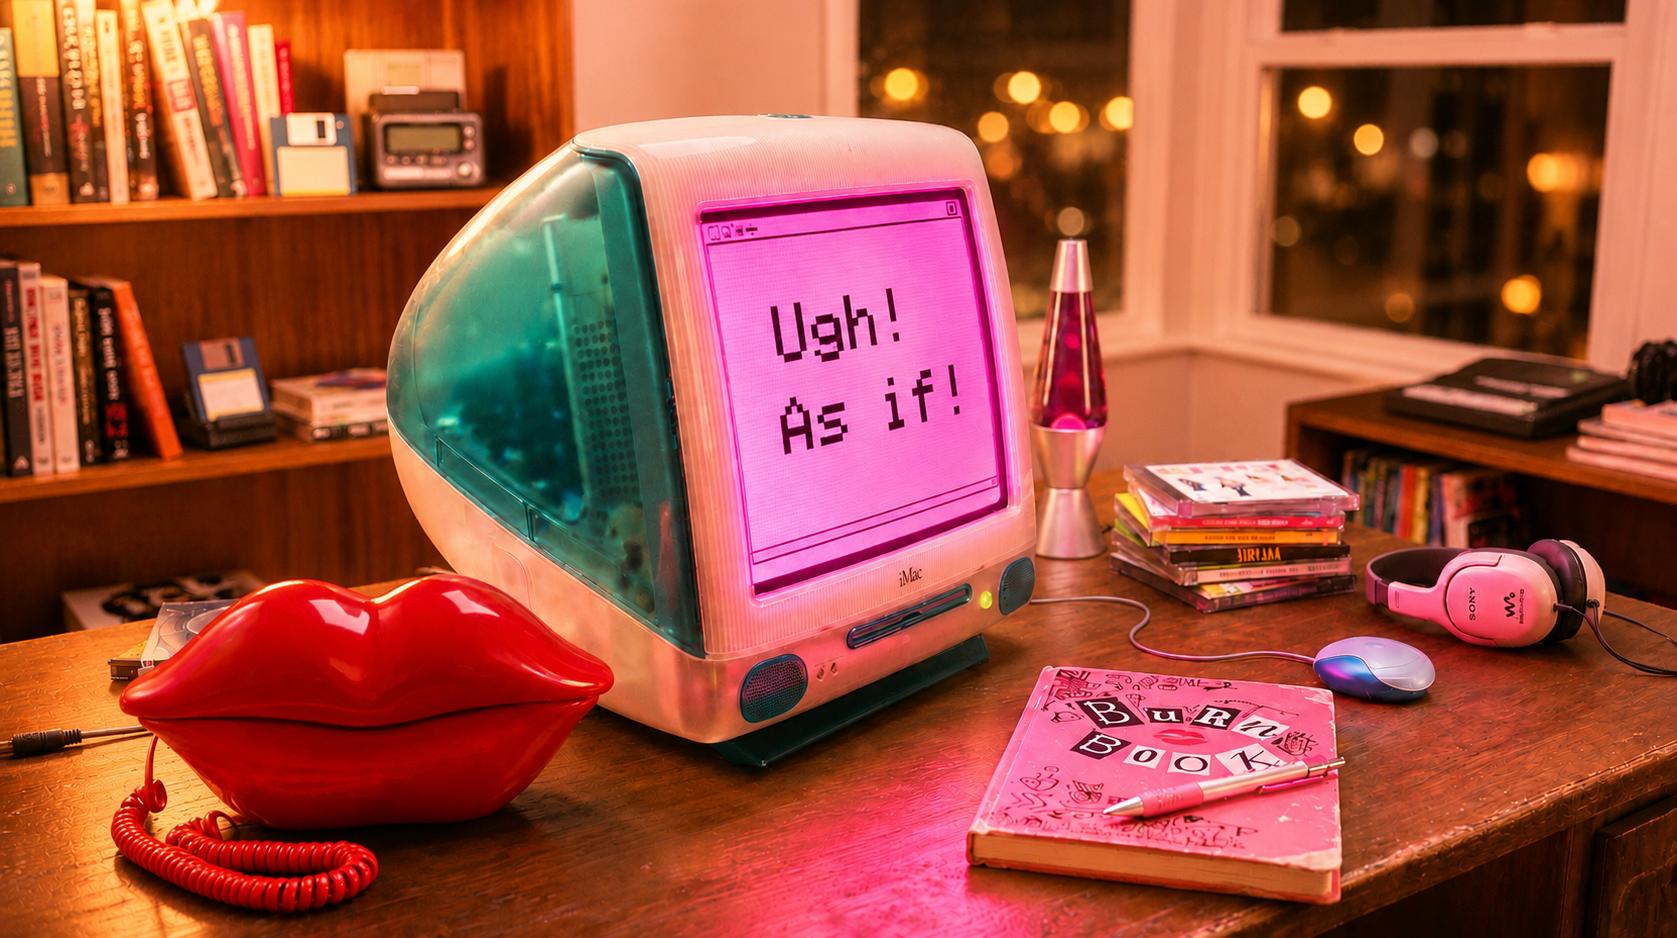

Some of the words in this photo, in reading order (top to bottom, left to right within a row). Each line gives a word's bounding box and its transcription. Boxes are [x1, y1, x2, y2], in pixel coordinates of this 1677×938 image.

[770, 288, 900, 363] Ugh!
[780, 396, 848, 455] As
[885, 364, 960, 431] if!
[899, 567, 922, 587] iMac
[1468, 587, 1476, 620] SONY
